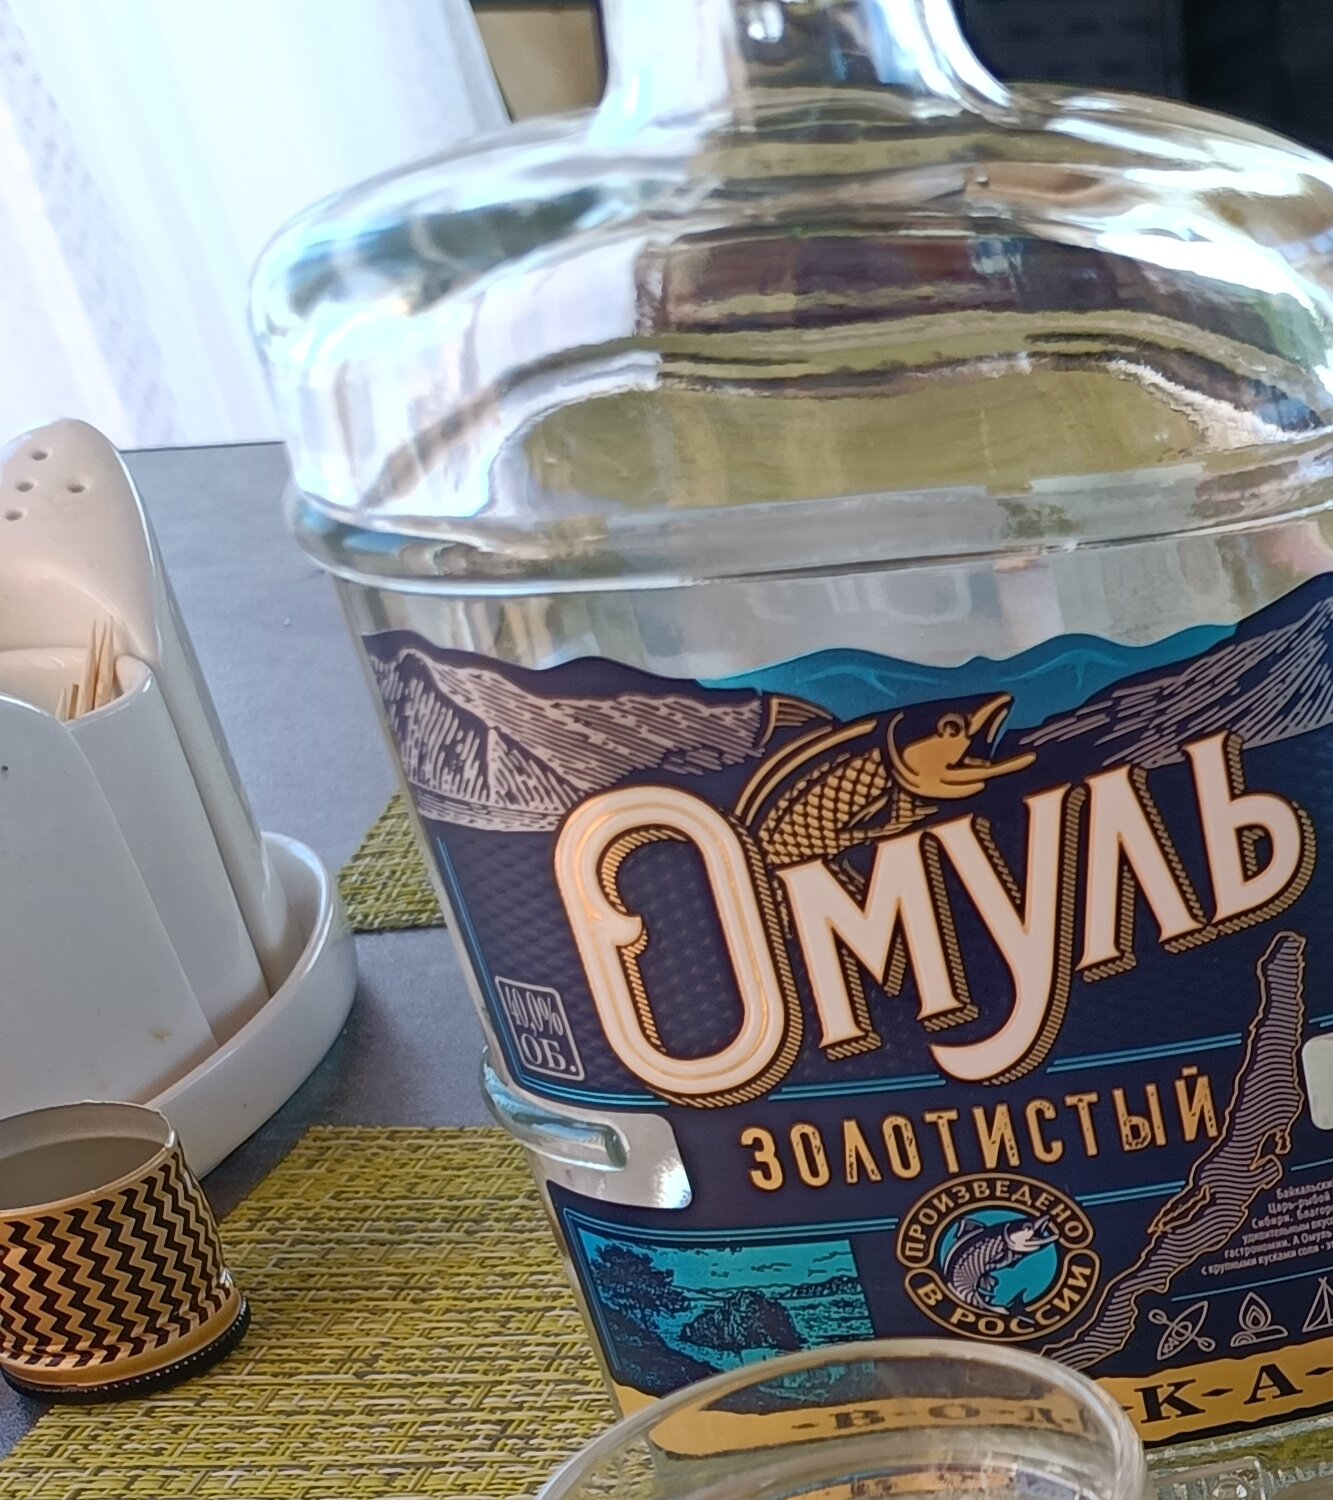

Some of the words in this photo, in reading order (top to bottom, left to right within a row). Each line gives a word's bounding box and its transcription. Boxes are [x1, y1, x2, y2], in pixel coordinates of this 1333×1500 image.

[504, 985, 565, 1037] 40,0%
[520, 1032, 577, 1073] ОБ.
[739, 1065, 1219, 1192] ЗОЛОТИСТЫЙ
[904, 1179, 1085, 1259] ПРОИЗВЕДЕНО
[1267, 1190, 1331, 1215] Царь-рыбой
[1242, 1222, 1310, 1246] удивительным
[1251, 1216, 1294, 1230] Сибири.
[1201, 1267, 1208, 1275] с
[1208, 1257, 1257, 1275] крупными
[1258, 1250, 1296, 1266] кусками
[1297, 1244, 1319, 1257] соли
[1224, 1240, 1292, 1259] гастрономии.
[1292, 1235, 1300, 1246] А
[1301, 1229, 1333, 1246] Омуль
[915, 1281, 944, 1307] В
[949, 1263, 1092, 1335] РОССИИ
